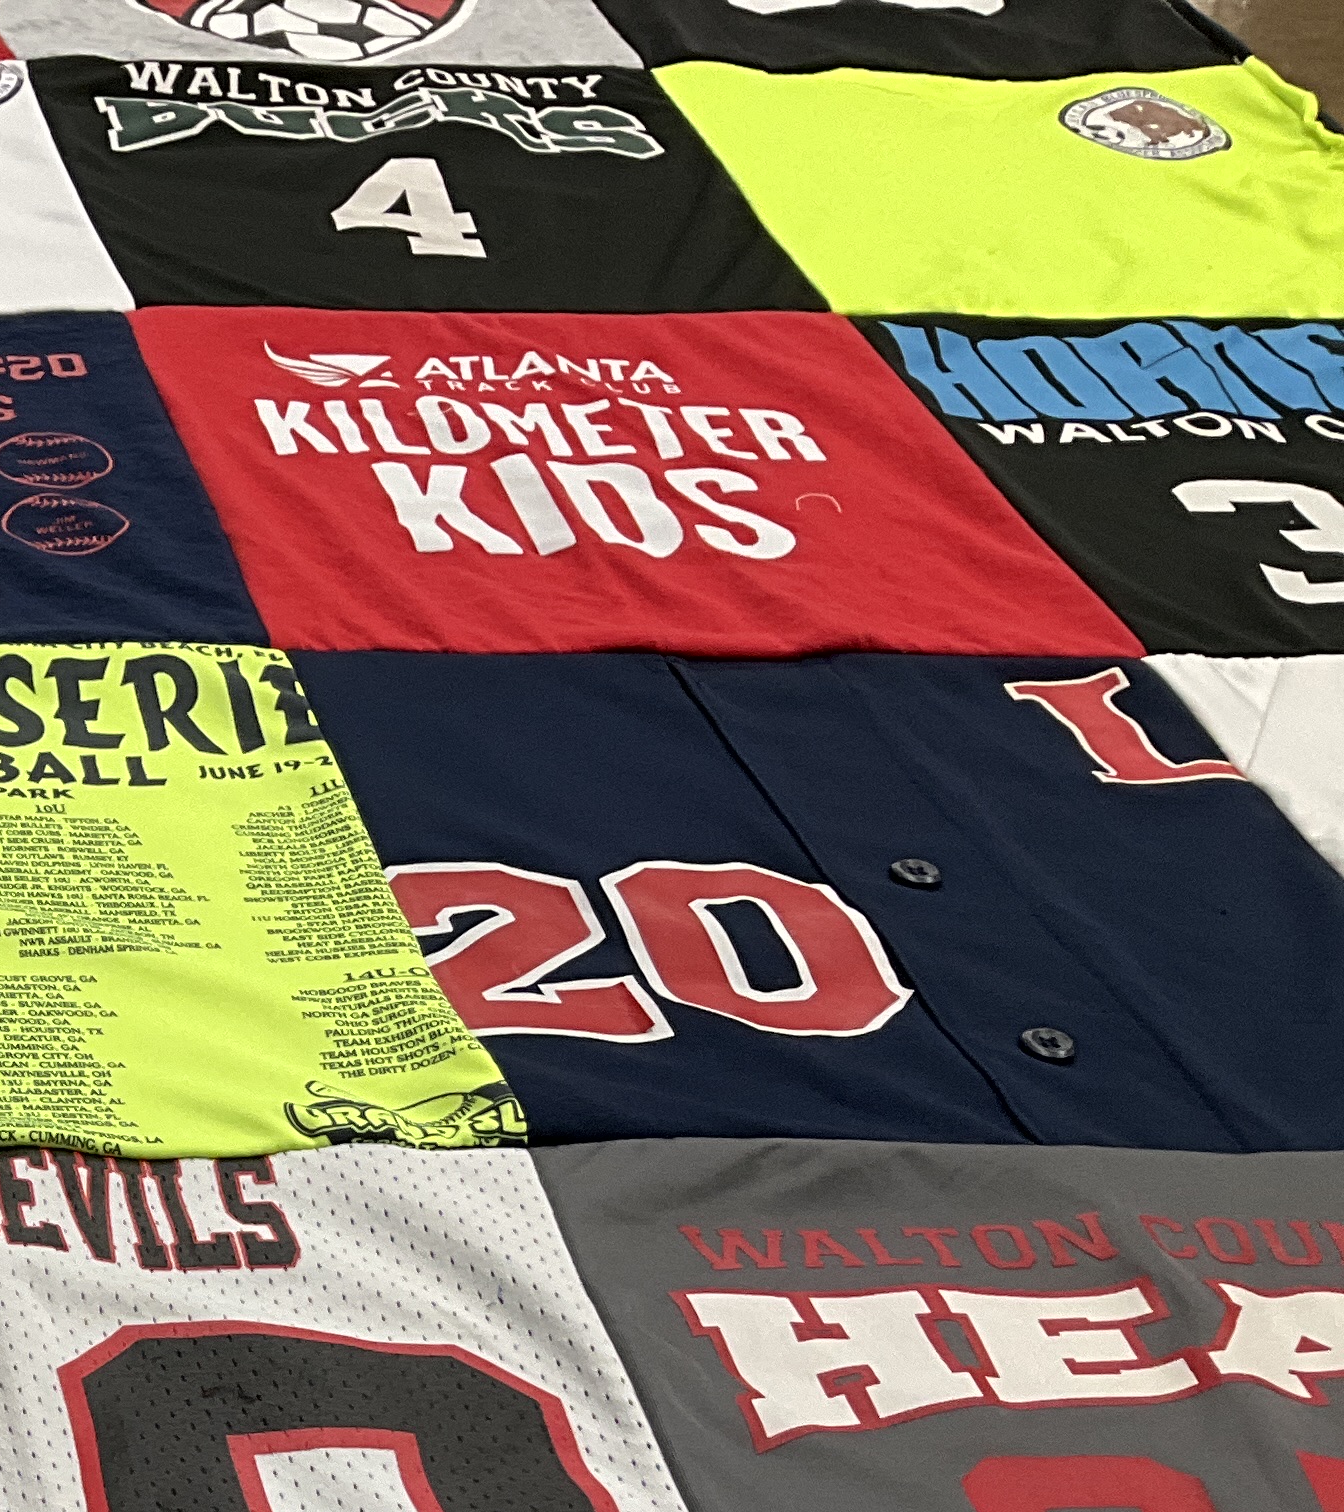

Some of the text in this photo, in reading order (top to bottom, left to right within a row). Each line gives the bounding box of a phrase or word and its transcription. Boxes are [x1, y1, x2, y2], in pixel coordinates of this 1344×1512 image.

[120, 61, 604, 110] WALTON COUNTY
[331, 158, 487, 259] 4
[413, 351, 676, 385] ATLANTA
[416, 378, 683, 395] TRACK CLUB
[253, 395, 827, 462] KILOMETER
[978, 411, 1288, 446] WALTON
[370, 453, 797, 559] KIDS
[1003, 667, 1253, 785] L
[198, 763, 265, 781] JUNE
[35, 803, 68, 815] 10U
[384, 860, 914, 1044] 20
[319, 1050, 357, 1060] TEAM
[361, 1036, 426, 1056] HOUSTON
[319, 1043, 439, 1070] TEXAS HOT SHOTS
[333, 1037, 371, 1047] TEAM
[338, 1047, 457, 1079] THE DIRTY DOZEN
[29, 1131, 99, 1154] CUMMING,
[103, 1142, 122, 1155] GA
[679, 1211, 1120, 1271] WALTON
